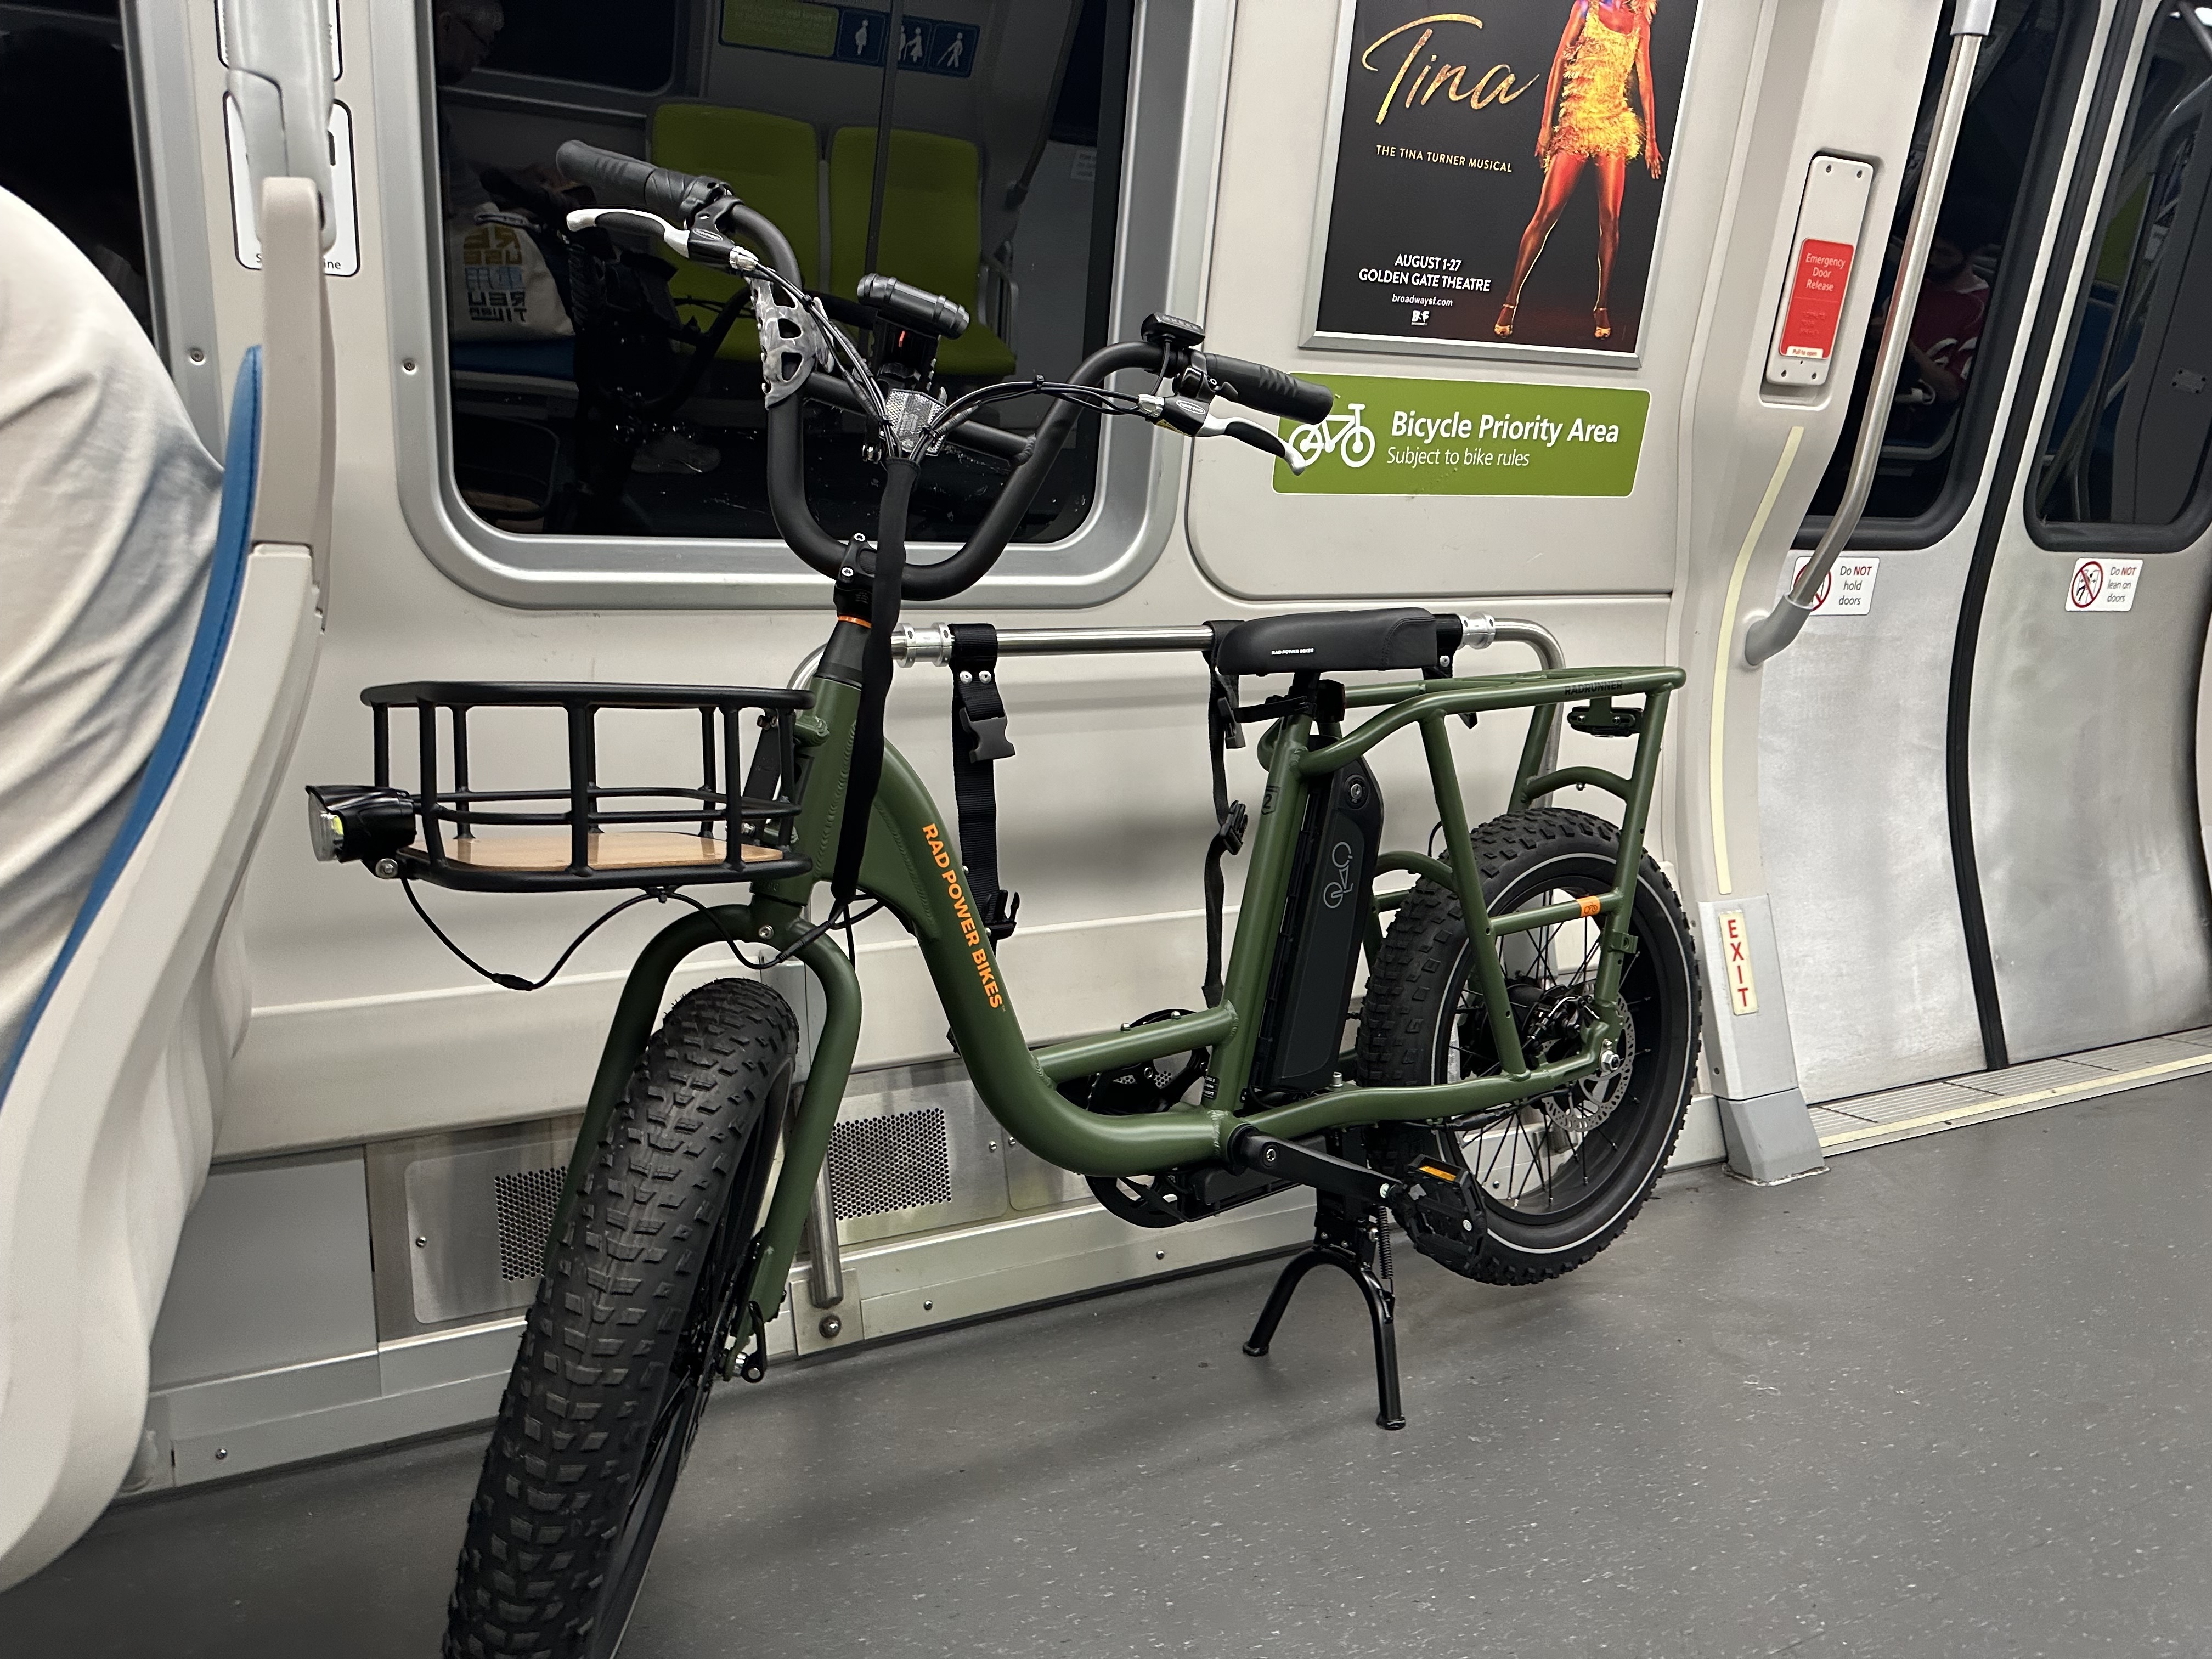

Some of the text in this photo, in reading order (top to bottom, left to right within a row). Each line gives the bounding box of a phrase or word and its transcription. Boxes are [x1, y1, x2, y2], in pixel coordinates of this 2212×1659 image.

[1361, 13, 1539, 125] Tina
[1376, 145, 1513, 173] THE TINA TURNER MUSICAL
[1394, 253, 1462, 272] AUGUST 1-27
[1805, 253, 1846, 269] Emergency
[1359, 268, 1491, 292] GOLDEN GATE THEATRE
[1813, 267, 1831, 278] Door
[1806, 280, 1834, 291] Release
[1392, 293, 1453, 307] broadwaysf.com
[1391, 411, 1620, 447] Bicycle Priority Area
[1386, 447, 1530, 469] Subject to bike rules
[1840, 566, 1872, 576] Do NOT
[2111, 567, 2137, 576] Do NOT
[1843, 580, 1862, 591] hold
[2107, 579, 2121, 589] lean
[1838, 594, 1861, 606] doors
[2107, 592, 2126, 602] doors
[1564, 680, 1623, 696] RADRUNNER
[922, 823, 950, 869] RAD
[941, 868, 980, 947] POWER
[1728, 919, 1748, 1007] EXIT
